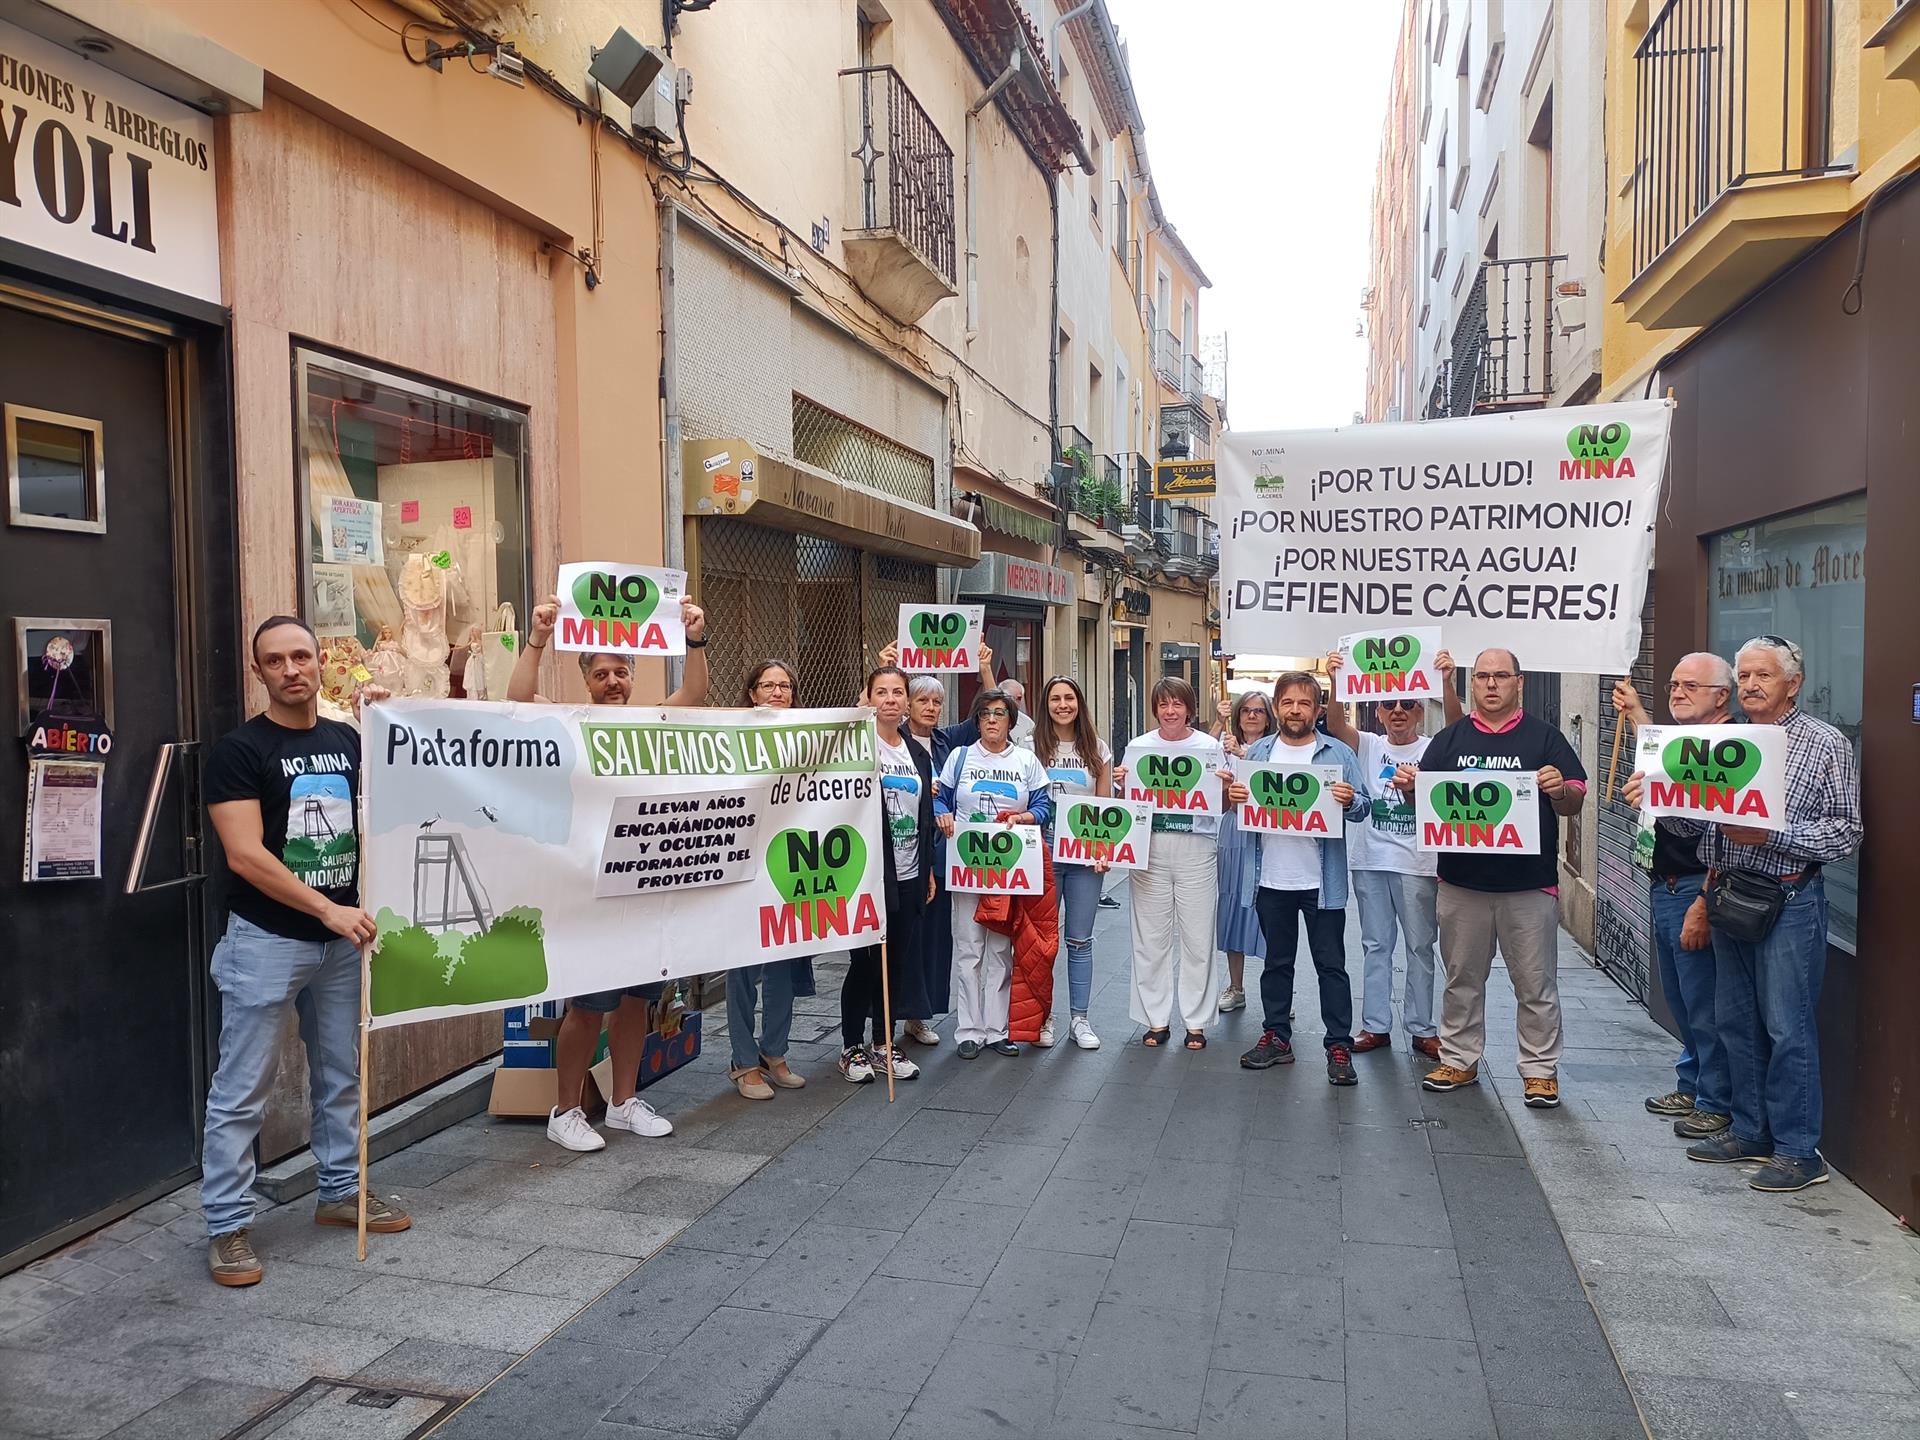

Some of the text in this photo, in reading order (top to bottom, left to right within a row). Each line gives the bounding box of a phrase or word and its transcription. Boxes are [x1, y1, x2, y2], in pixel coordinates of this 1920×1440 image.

[82, 90, 95, 123] Y
[104, 101, 208, 171] ARREGLOS
[0, 99, 156, 253] YOLI
[1578, 423, 1622, 446] NO
[1580, 447, 1609, 457] A LA
[1172, 465, 1213, 474] RETALES
[1311, 460, 1533, 501] ¡POR TU SALUD!
[1559, 457, 1636, 481] MINA
[1232, 500, 1632, 539] ¡POR NUESTRO PATRIMONIO!
[1274, 546, 1577, 577] ¡POR NUESTRA AGUA!
[1737, 560, 1779, 596] morada
[1785, 557, 1800, 589] de
[1810, 545, 1866, 589] More
[590, 574, 647, 603] NO
[1227, 574, 1619, 621] ¡DEFIENDE CÁCERES!
[592, 605, 632, 618] A LA
[563, 618, 668, 649] MINA
[921, 614, 959, 634] NO
[922, 637, 948, 646] A LA
[1366, 636, 1410, 659] NO
[902, 648, 969, 668] MINA
[1368, 660, 1399, 671] A LA
[1347, 670, 1429, 694] MINA
[32, 724, 111, 753] ABIERTO
[387, 724, 560, 767] Plataforma
[592, 722, 873, 776] SALVEMOS LA MONTAÑA
[281, 757, 304, 777] NO
[311, 753, 352, 773] MINA
[1457, 756, 1477, 767] NO
[1485, 756, 1521, 769] MINA
[1680, 739, 1746, 768] NO
[970, 769, 985, 780] NO
[993, 769, 1021, 782] MINA
[1149, 756, 1192, 776] NO
[1683, 770, 1728, 783] A LA
[771, 769, 872, 805] de Cáceres
[1152, 778, 1181, 787] A LA
[1262, 772, 1309, 795] NO
[638, 795, 745, 815] LLEVAN AÑOS
[1131, 788, 1208, 810] MINA
[1266, 796, 1297, 807] A LA
[1446, 782, 1499, 807] NO
[1651, 781, 1769, 818] MINA
[614, 814, 756, 838] ENGAÑÁNDONOS
[1080, 805, 1123, 828] NO
[1244, 805, 1328, 832] MINA
[1450, 810, 1487, 820] A LA
[639, 833, 735, 854] Y OCULTAN
[969, 832, 1013, 853] NO
[1081, 829, 1111, 839] A LA
[1424, 822, 1523, 848] MINA
[604, 849, 750, 874] INFORMACIÓN DEL
[786, 828, 851, 872] NO
[971, 856, 1002, 865] A LA
[1059, 837, 1136, 864] MINA
[304, 863, 356, 887] MONTAÑ
[637, 869, 724, 889] PROYECTO
[793, 875, 837, 897] A LA
[951, 866, 1030, 889] MINA
[760, 893, 879, 947] MINA
